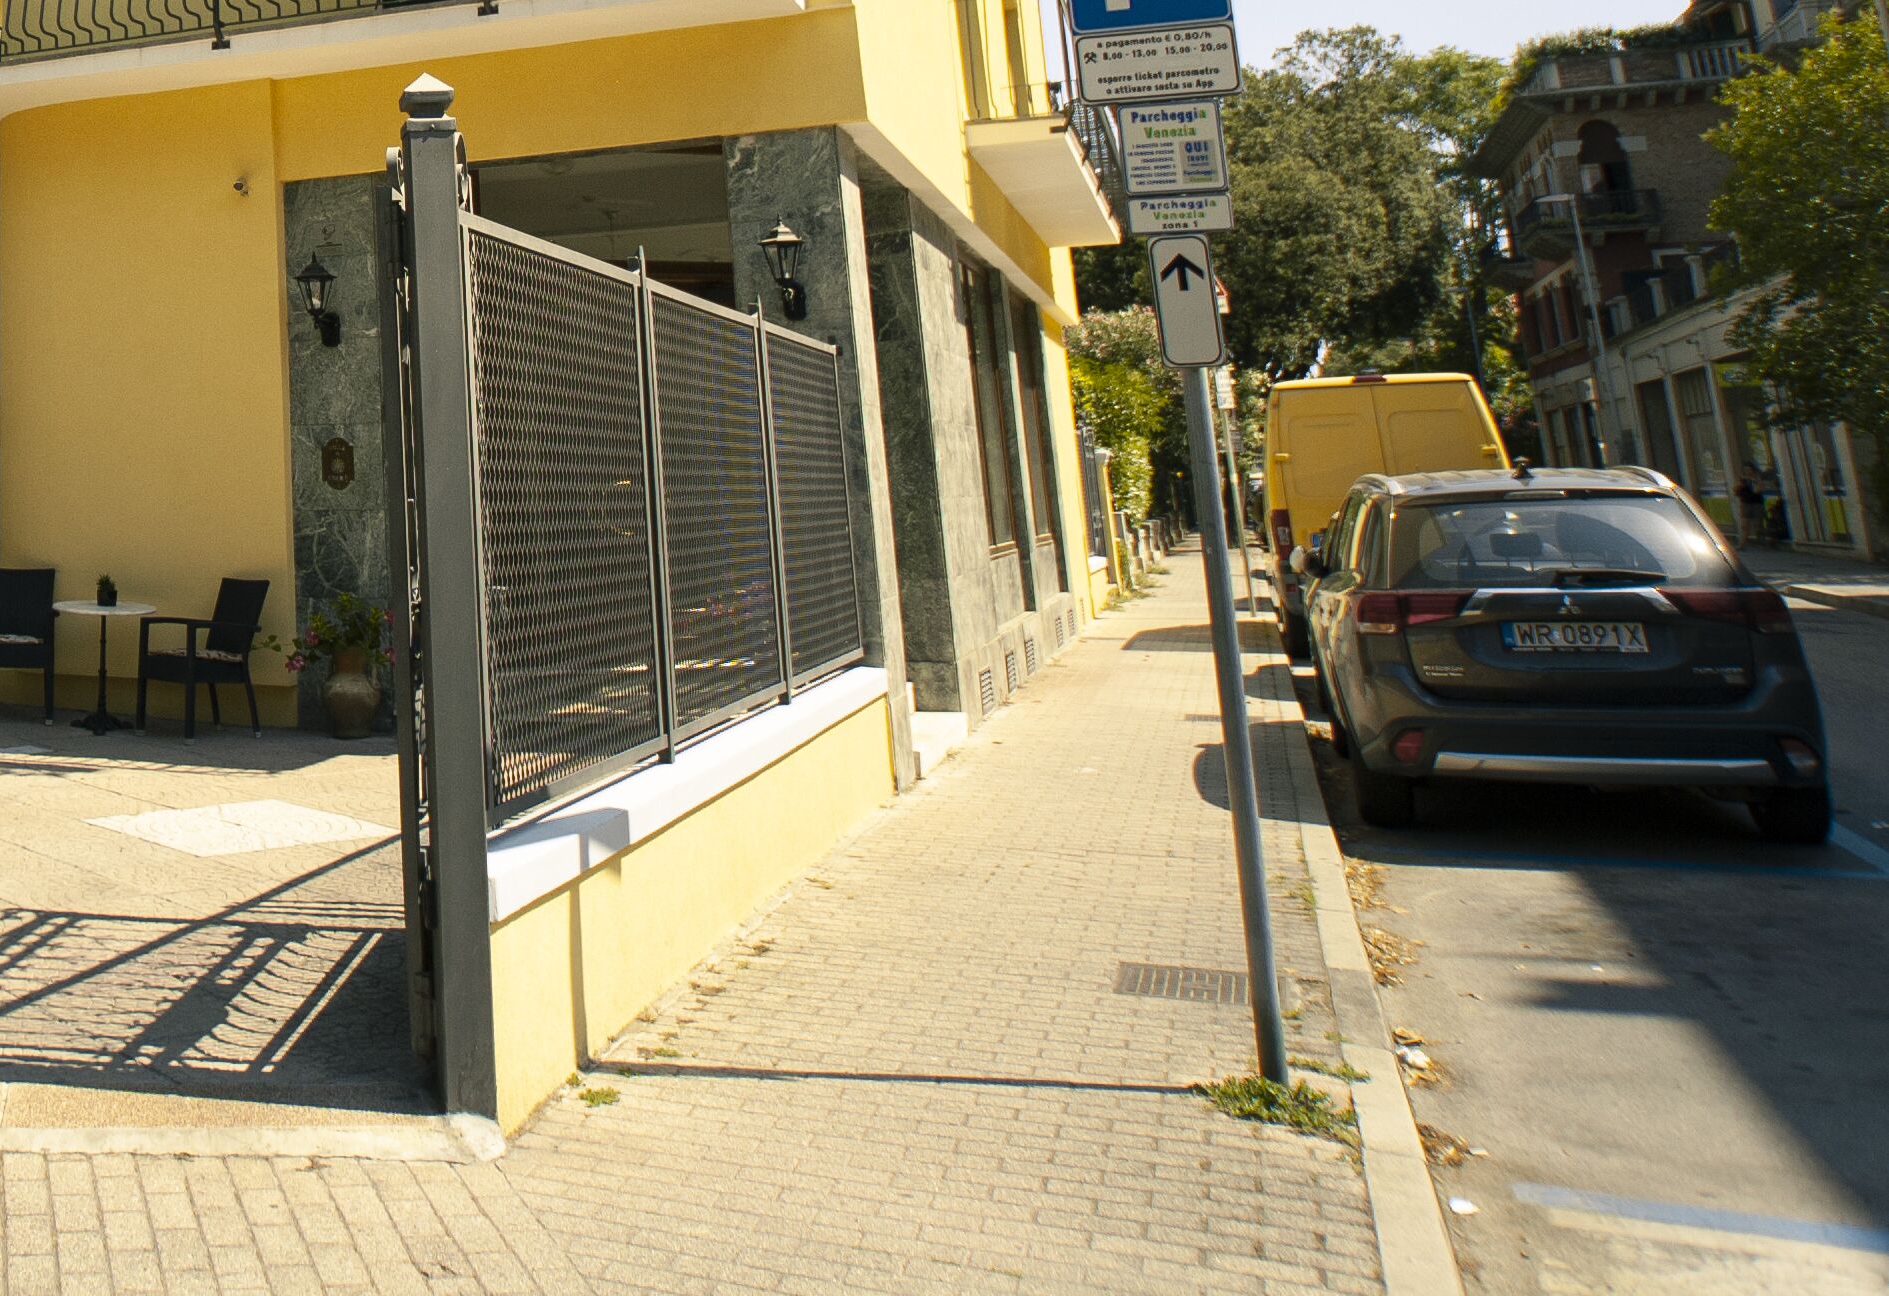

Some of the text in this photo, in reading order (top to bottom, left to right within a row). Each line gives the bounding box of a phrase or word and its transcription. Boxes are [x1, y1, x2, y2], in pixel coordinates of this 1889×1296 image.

[1105, 35, 1163, 49] pagamento
[1173, 31, 1212, 42] 0,80/h
[1097, 66, 1220, 85] esporre ticket parcometro
[1114, 84, 1152, 94] attivare
[1154, 81, 1179, 92] sosta
[1182, 81, 1193, 89] su
[1143, 125, 1196, 139] Venezia
[1153, 210, 1205, 220] Venezia
[1162, 220, 1199, 230] zona 1
[1516, 623, 1556, 645] WR
